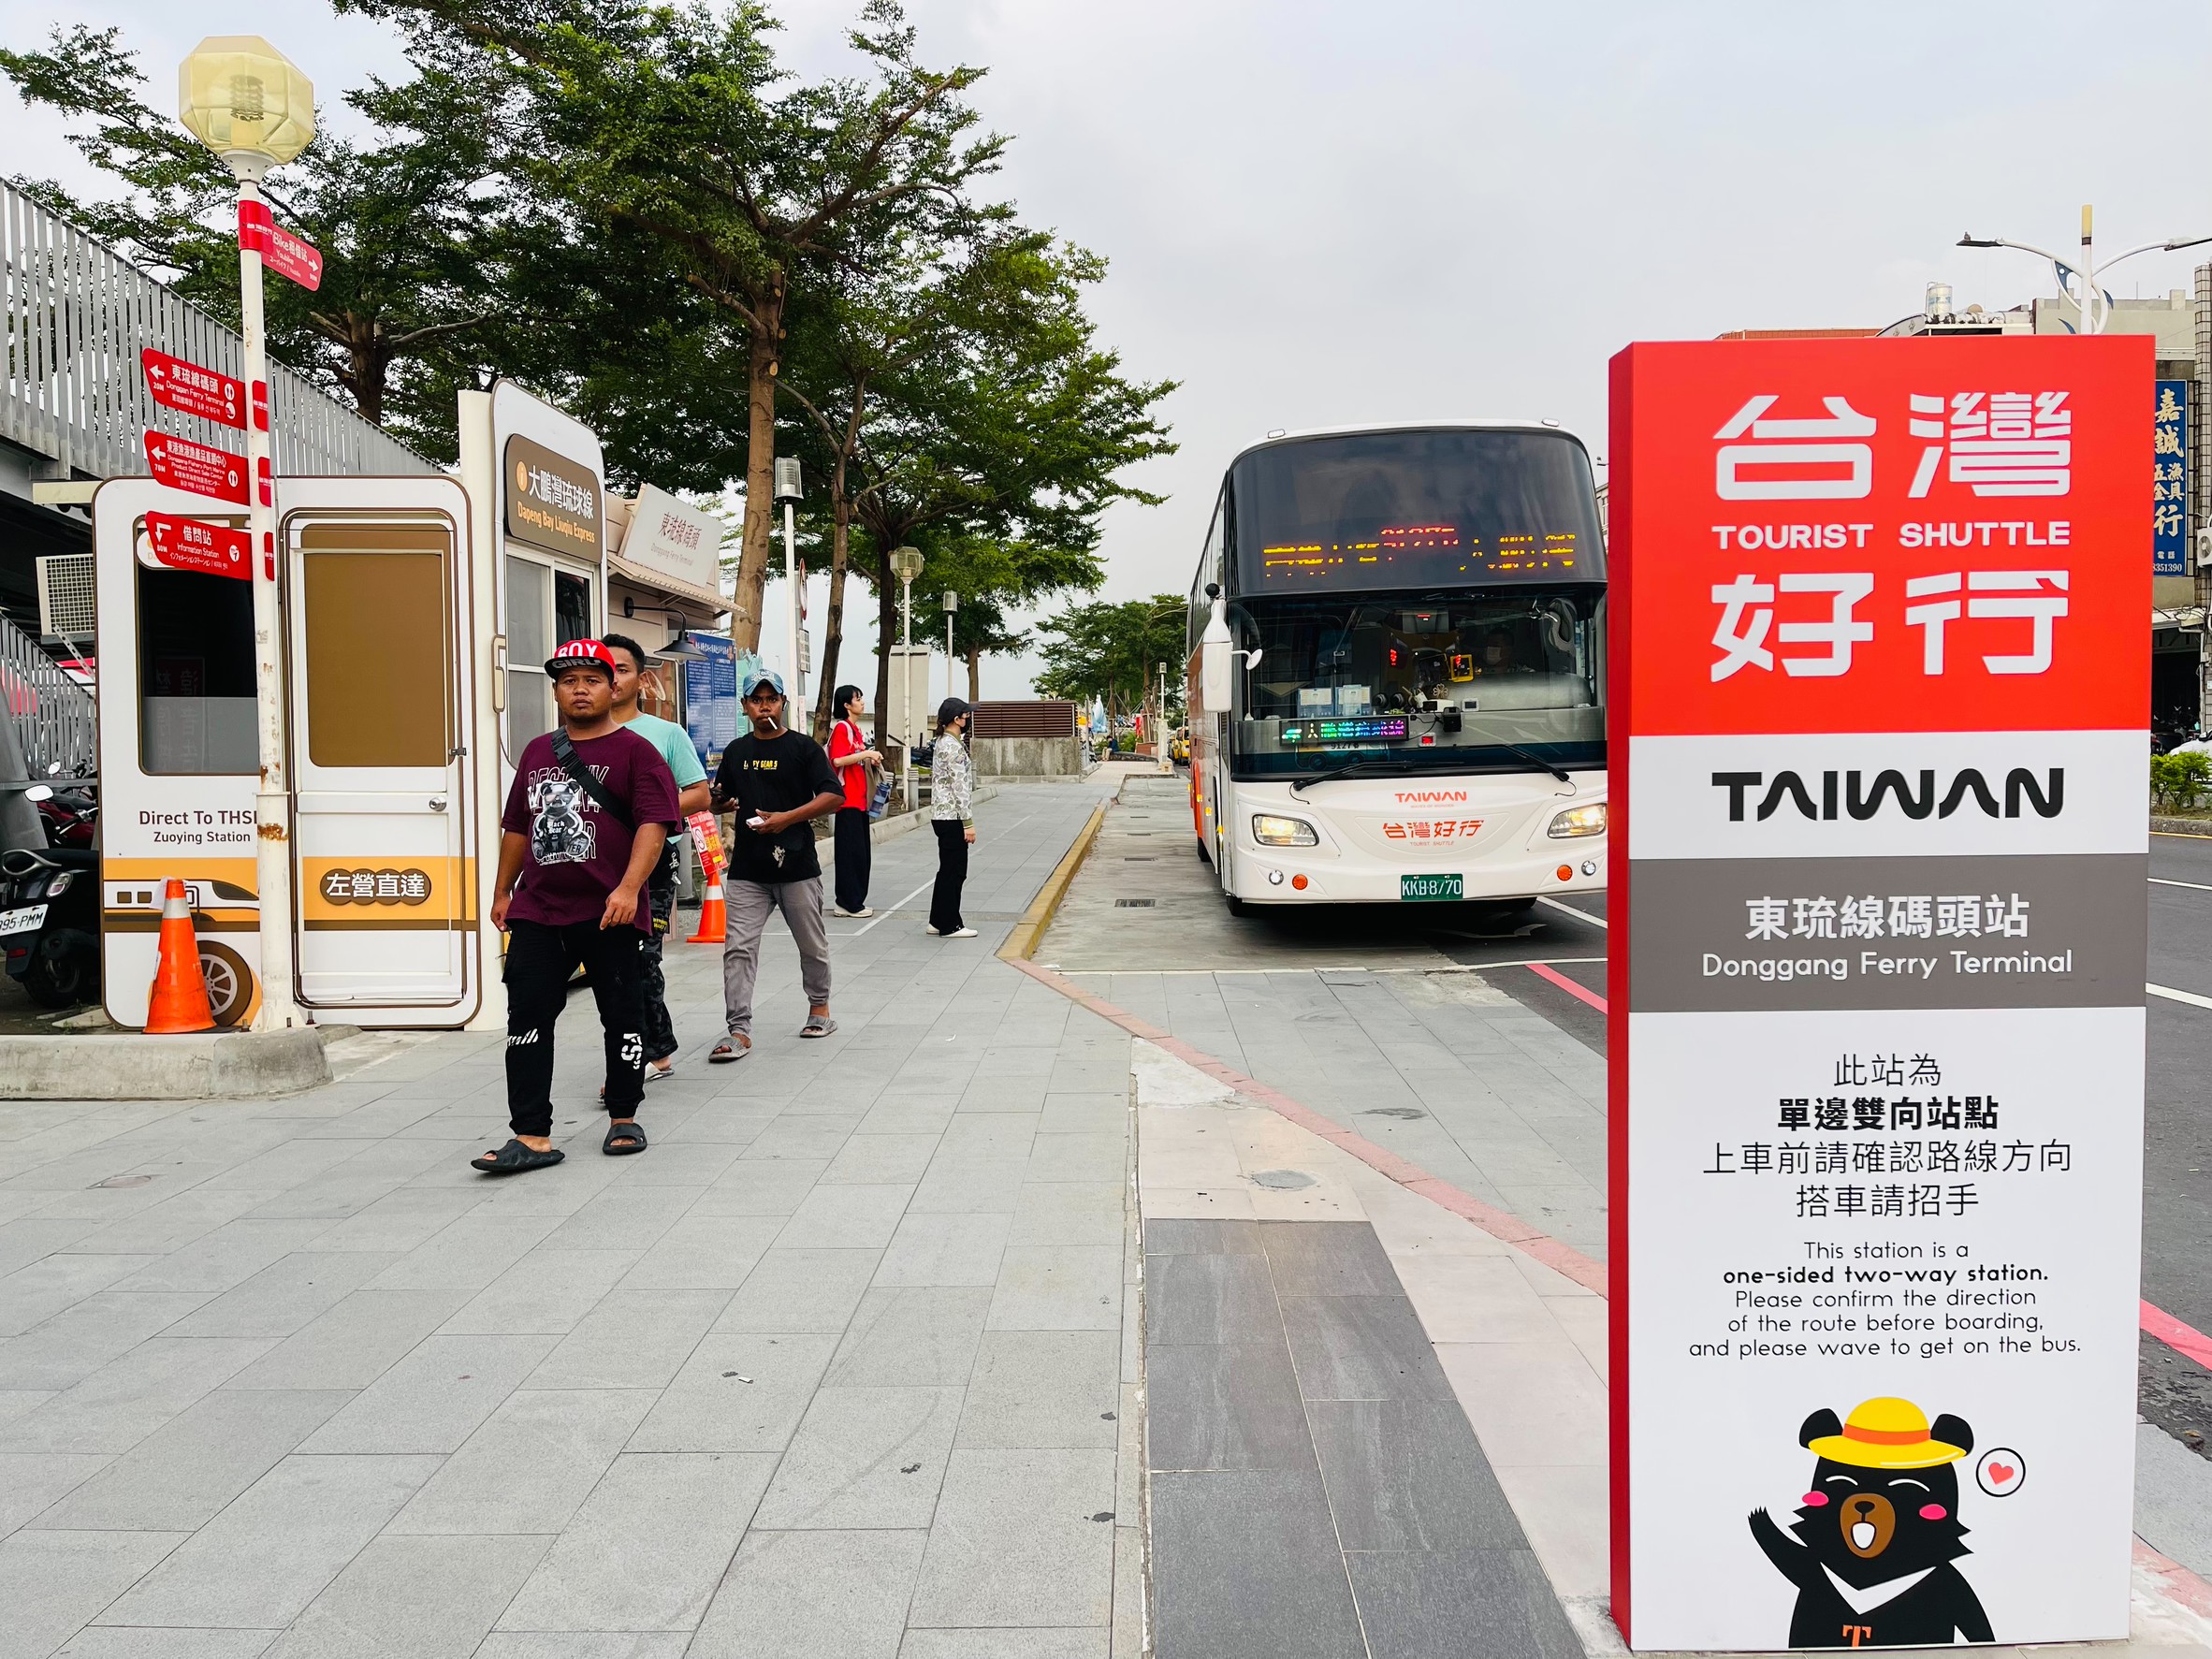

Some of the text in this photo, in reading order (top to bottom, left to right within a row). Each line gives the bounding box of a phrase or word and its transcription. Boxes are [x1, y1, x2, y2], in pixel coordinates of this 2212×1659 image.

[171, 364, 219, 395] 東琉線碼頭
[190, 389, 204, 400] Ferry
[205, 394, 225, 407] Terminal
[1714, 392, 2071, 500] 台灣
[528, 464, 594, 520] 大鵬灣琉球線
[517, 501, 595, 543] Dapeng Bay Liuqiu Express
[1712, 521, 2070, 549] TOURIST SHUTTLE
[182, 525, 212, 546] 借問站
[177, 543, 220, 559] Information Station
[1711, 571, 2069, 681] 好行
[557, 642, 598, 658] BOY
[1394, 791, 1467, 803] TAIWAN
[1711, 767, 2065, 822] TAIWAN
[139, 810, 257, 824] Direct To THS
[1382, 820, 1485, 839] 台灣好行
[153, 831, 251, 845] Zuoying Station
[326, 872, 426, 898] 左營直達
[1744, 894, 2030, 940] 東琉線碼頭站
[1703, 950, 2073, 982] Donggang Ferry Terminal
[1833, 1053, 1942, 1087] 此站為
[1777, 1096, 2000, 1131] 單邊雙向站點
[1703, 1139, 2072, 1175] 上車前請確認路線方向
[1796, 1183, 1979, 1218] 搭車請招手
[1804, 1242, 1969, 1259] This station is a
[1723, 1264, 2048, 1286] one-sided two-way station.
[1736, 1288, 2036, 1308] Please confirm the direction
[1727, 1313, 2044, 1332] of the route before boarding,
[1689, 1335, 2081, 1360] and please wave to get on the bus.
